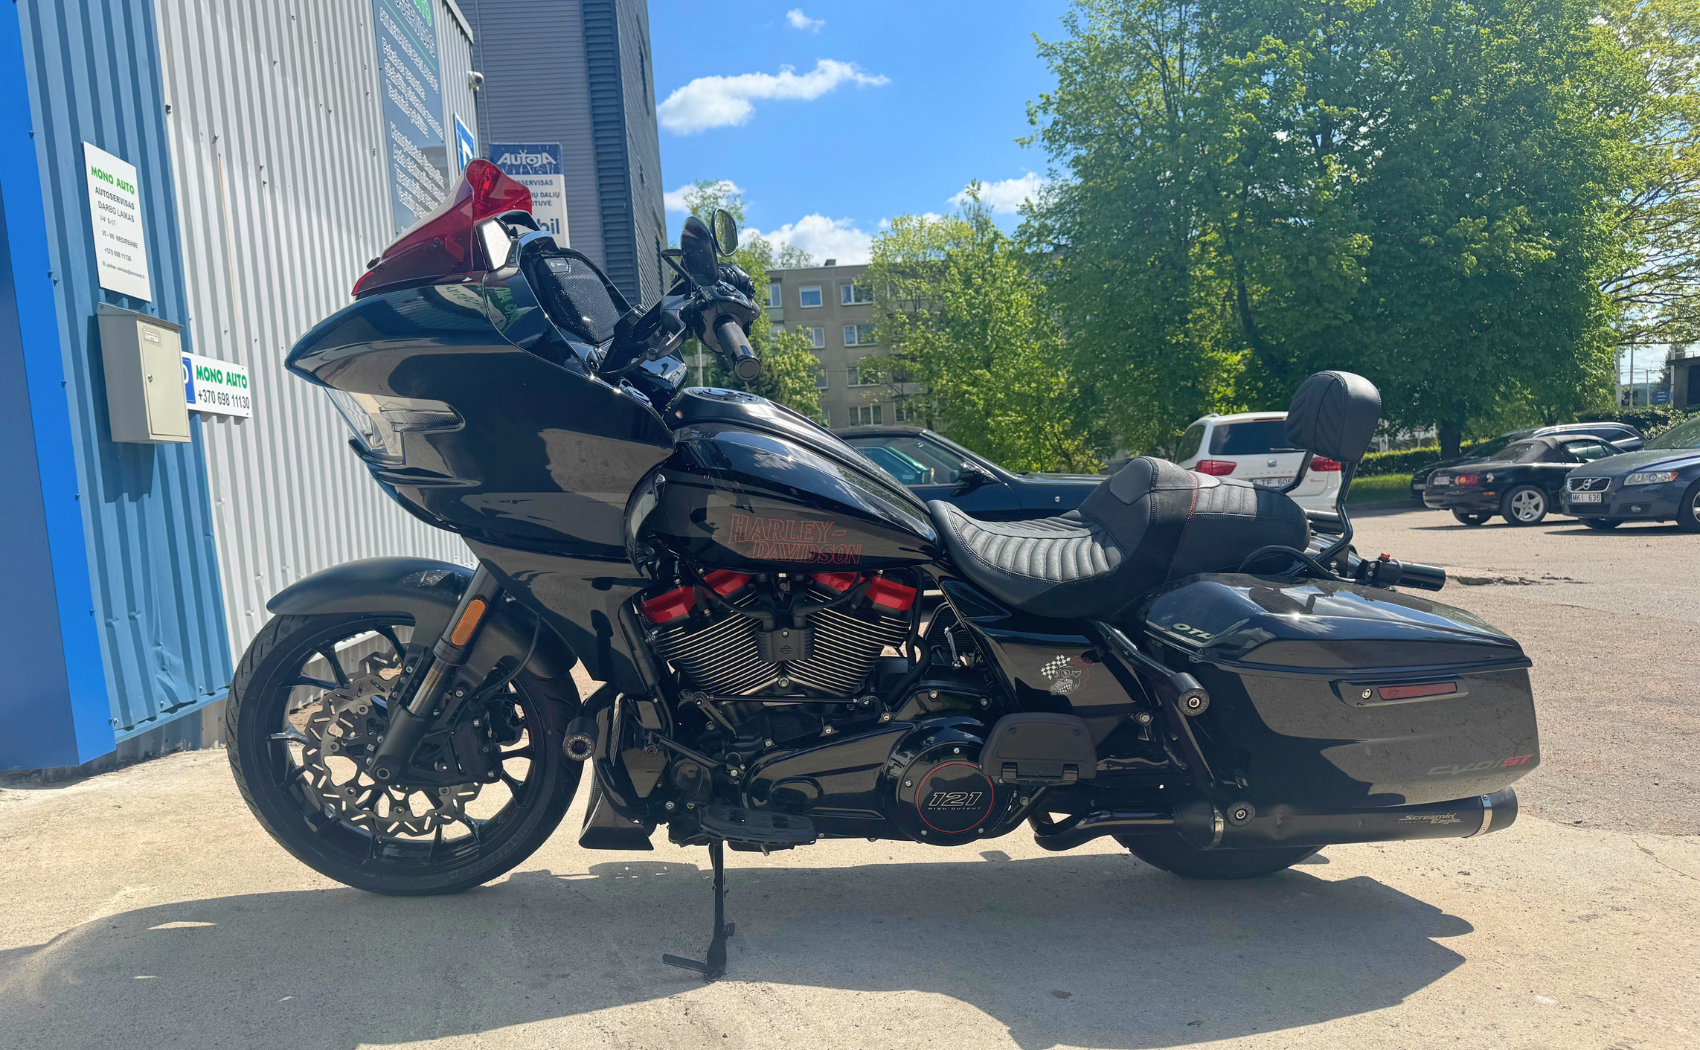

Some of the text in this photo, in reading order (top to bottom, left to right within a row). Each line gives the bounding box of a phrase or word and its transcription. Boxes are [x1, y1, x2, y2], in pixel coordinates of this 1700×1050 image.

[91, 165, 135, 195] MONO AUTO
[95, 186, 135, 210] AUTOSERVISAS
[98, 200, 135, 223] DARBO LAIKAS
[195, 364, 223, 385] MONO
[226, 371, 248, 389] AUTO
[198, 389, 250, 410] +370 698 11130
[752, 539, 863, 564] DAVIDSON
[928, 792, 983, 807] 121
